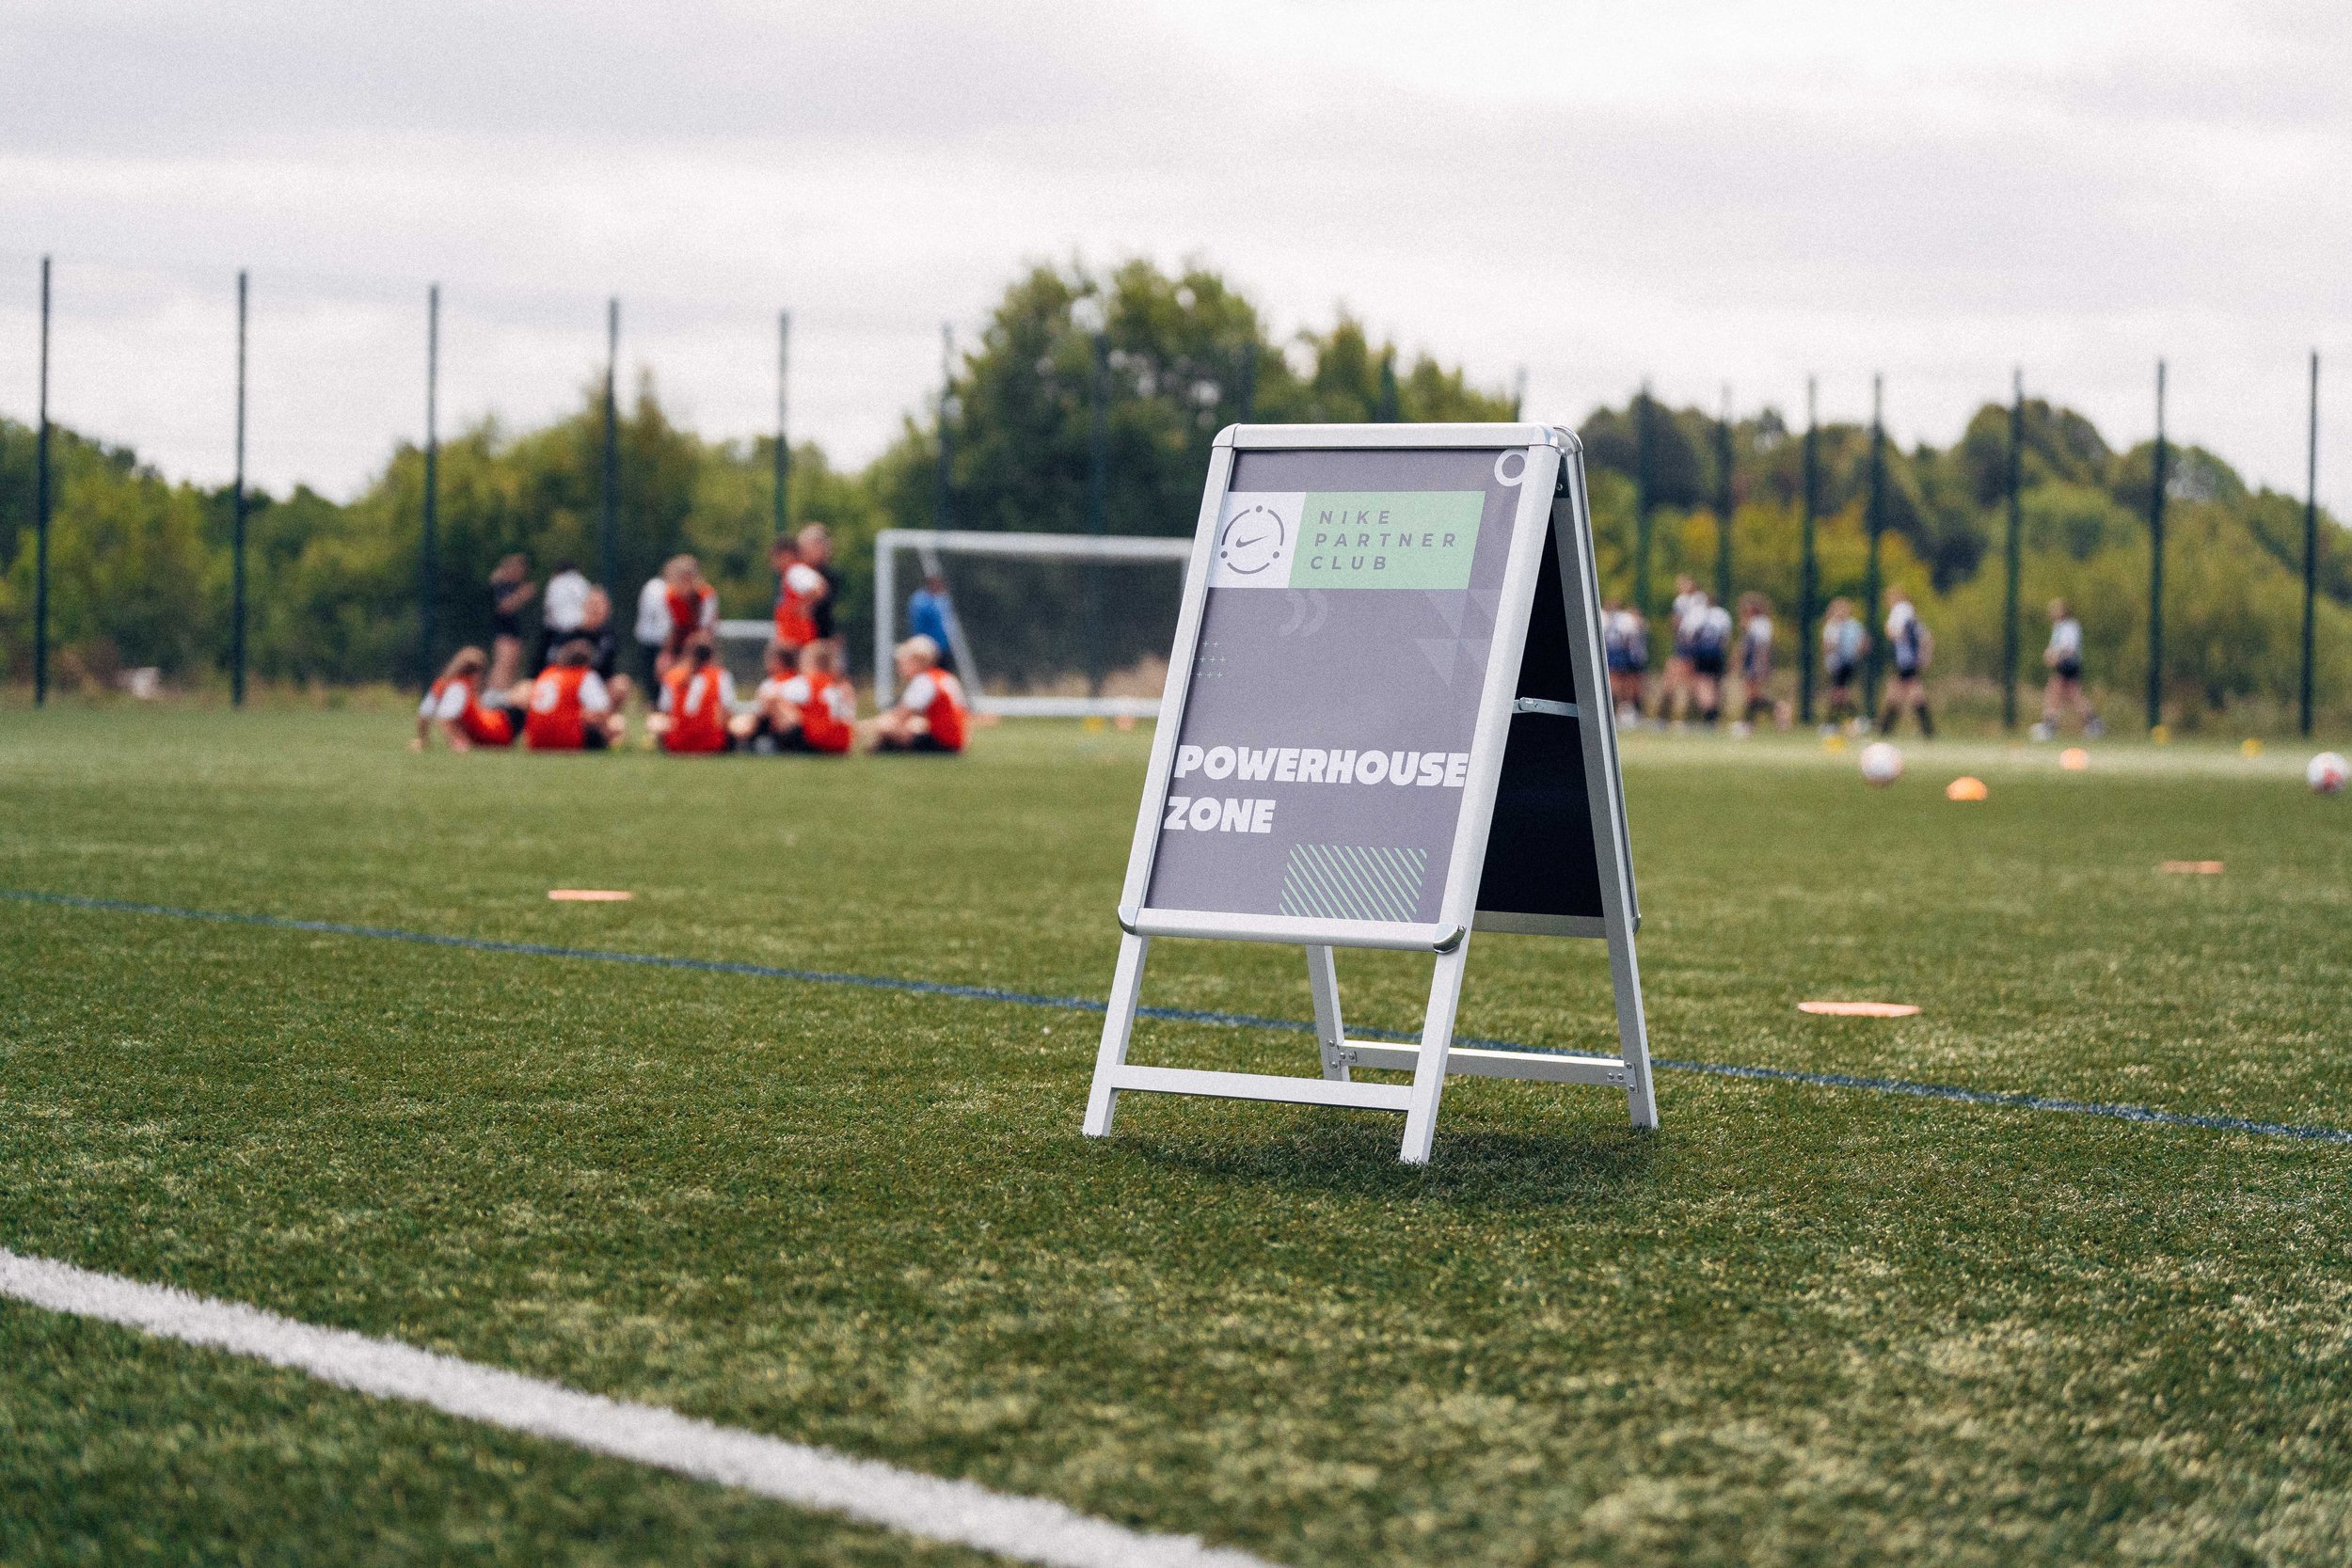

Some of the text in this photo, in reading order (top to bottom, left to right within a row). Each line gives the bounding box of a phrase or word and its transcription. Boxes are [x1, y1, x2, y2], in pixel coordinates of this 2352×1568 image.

[1319, 510, 1391, 525] NIKE
[1314, 533, 1456, 547] PARTNER
[1311, 556, 1387, 570] CLUB
[1174, 745, 1470, 787] POWERHOUSE
[1164, 797, 1276, 833] ZONE
